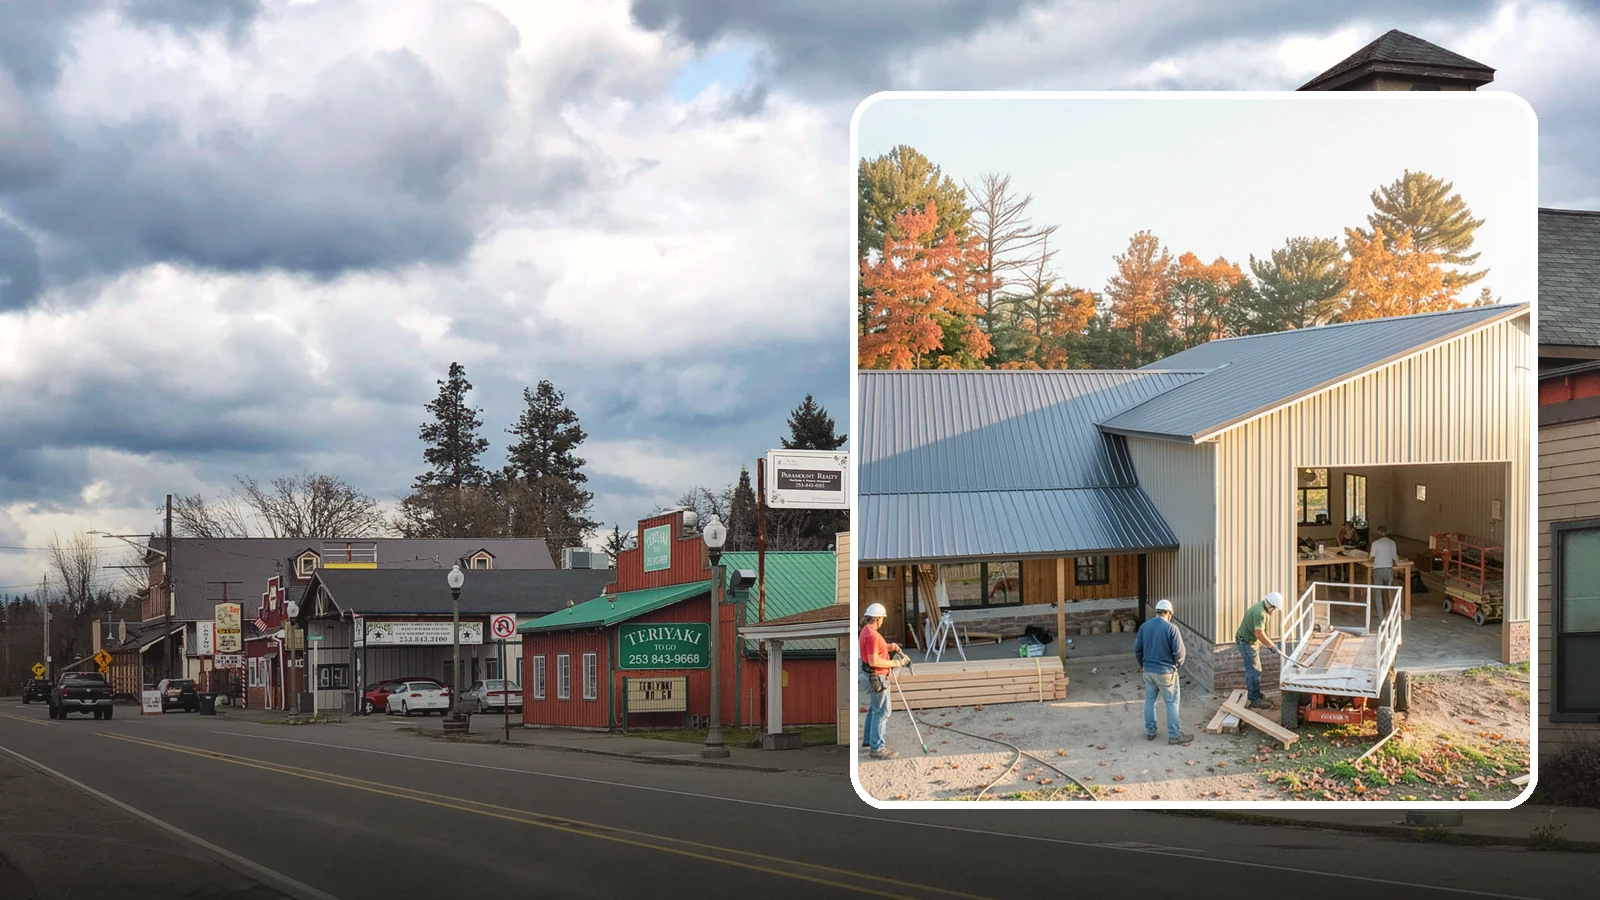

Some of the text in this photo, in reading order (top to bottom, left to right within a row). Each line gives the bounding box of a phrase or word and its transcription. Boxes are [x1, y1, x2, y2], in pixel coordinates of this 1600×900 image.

[781, 471, 839, 480] PARAMOUNT REALTY
[624, 627, 702, 646] TERIYAKI
[628, 653, 700, 664] 253 843-9668
